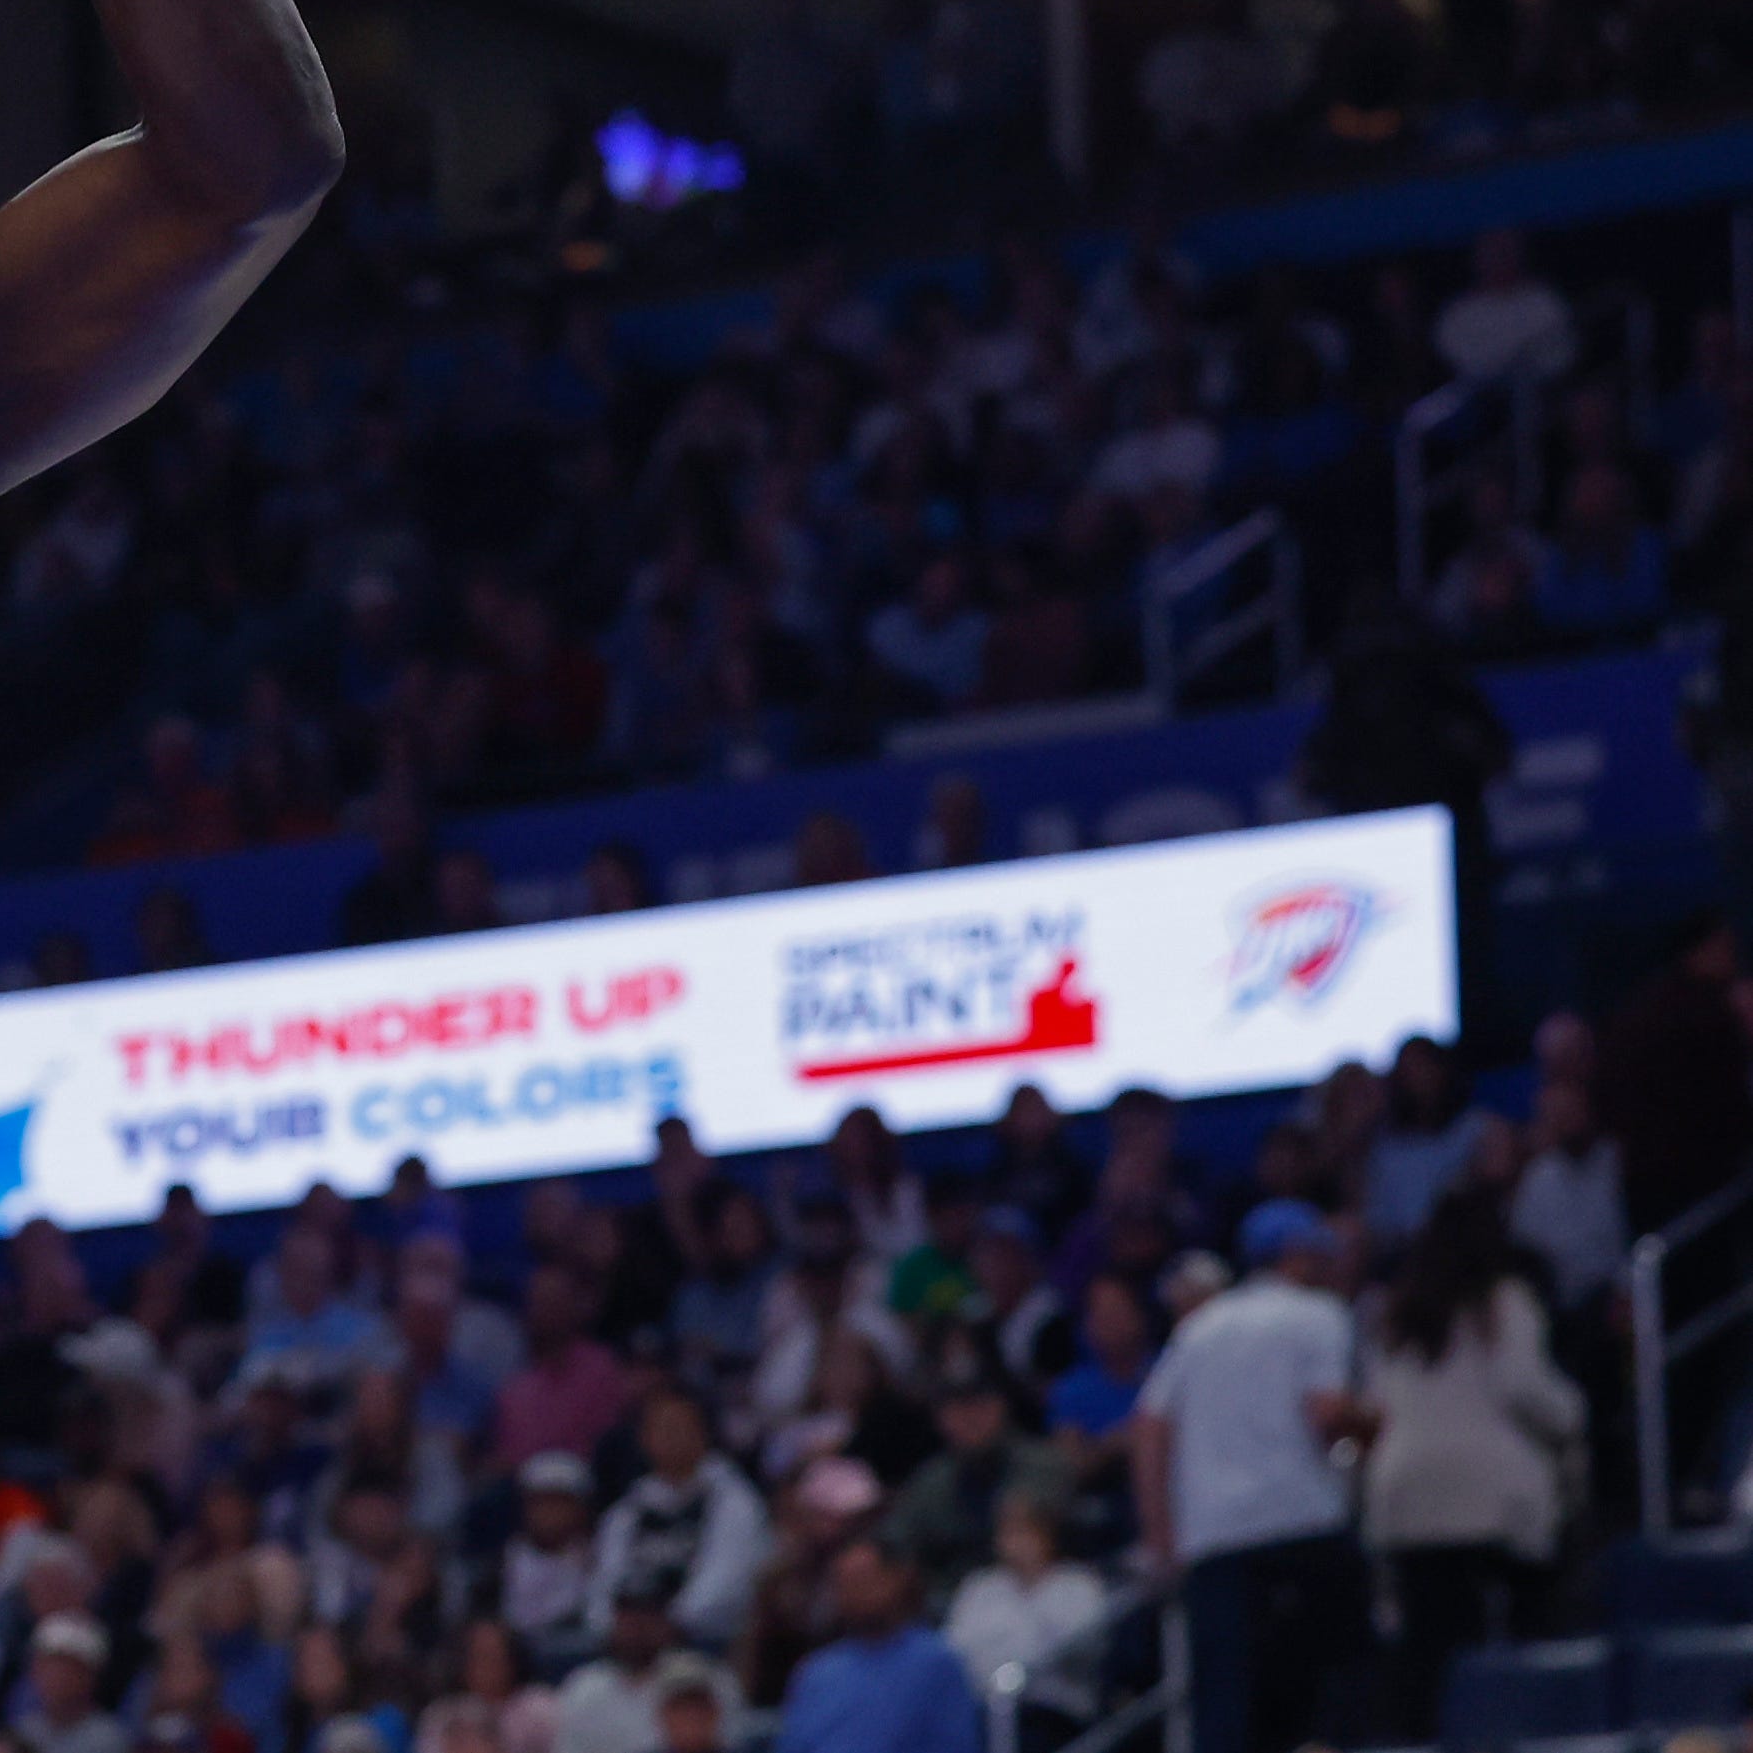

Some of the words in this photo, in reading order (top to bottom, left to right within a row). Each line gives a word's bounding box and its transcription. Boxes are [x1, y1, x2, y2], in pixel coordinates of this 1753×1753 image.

[117, 986, 536, 1086] THUNDER
[565, 968, 683, 1032] UP
[782, 953, 1018, 1038] PAINT
[115, 1094, 326, 1162] YOUR
[351, 1050, 681, 1140] COLORS
